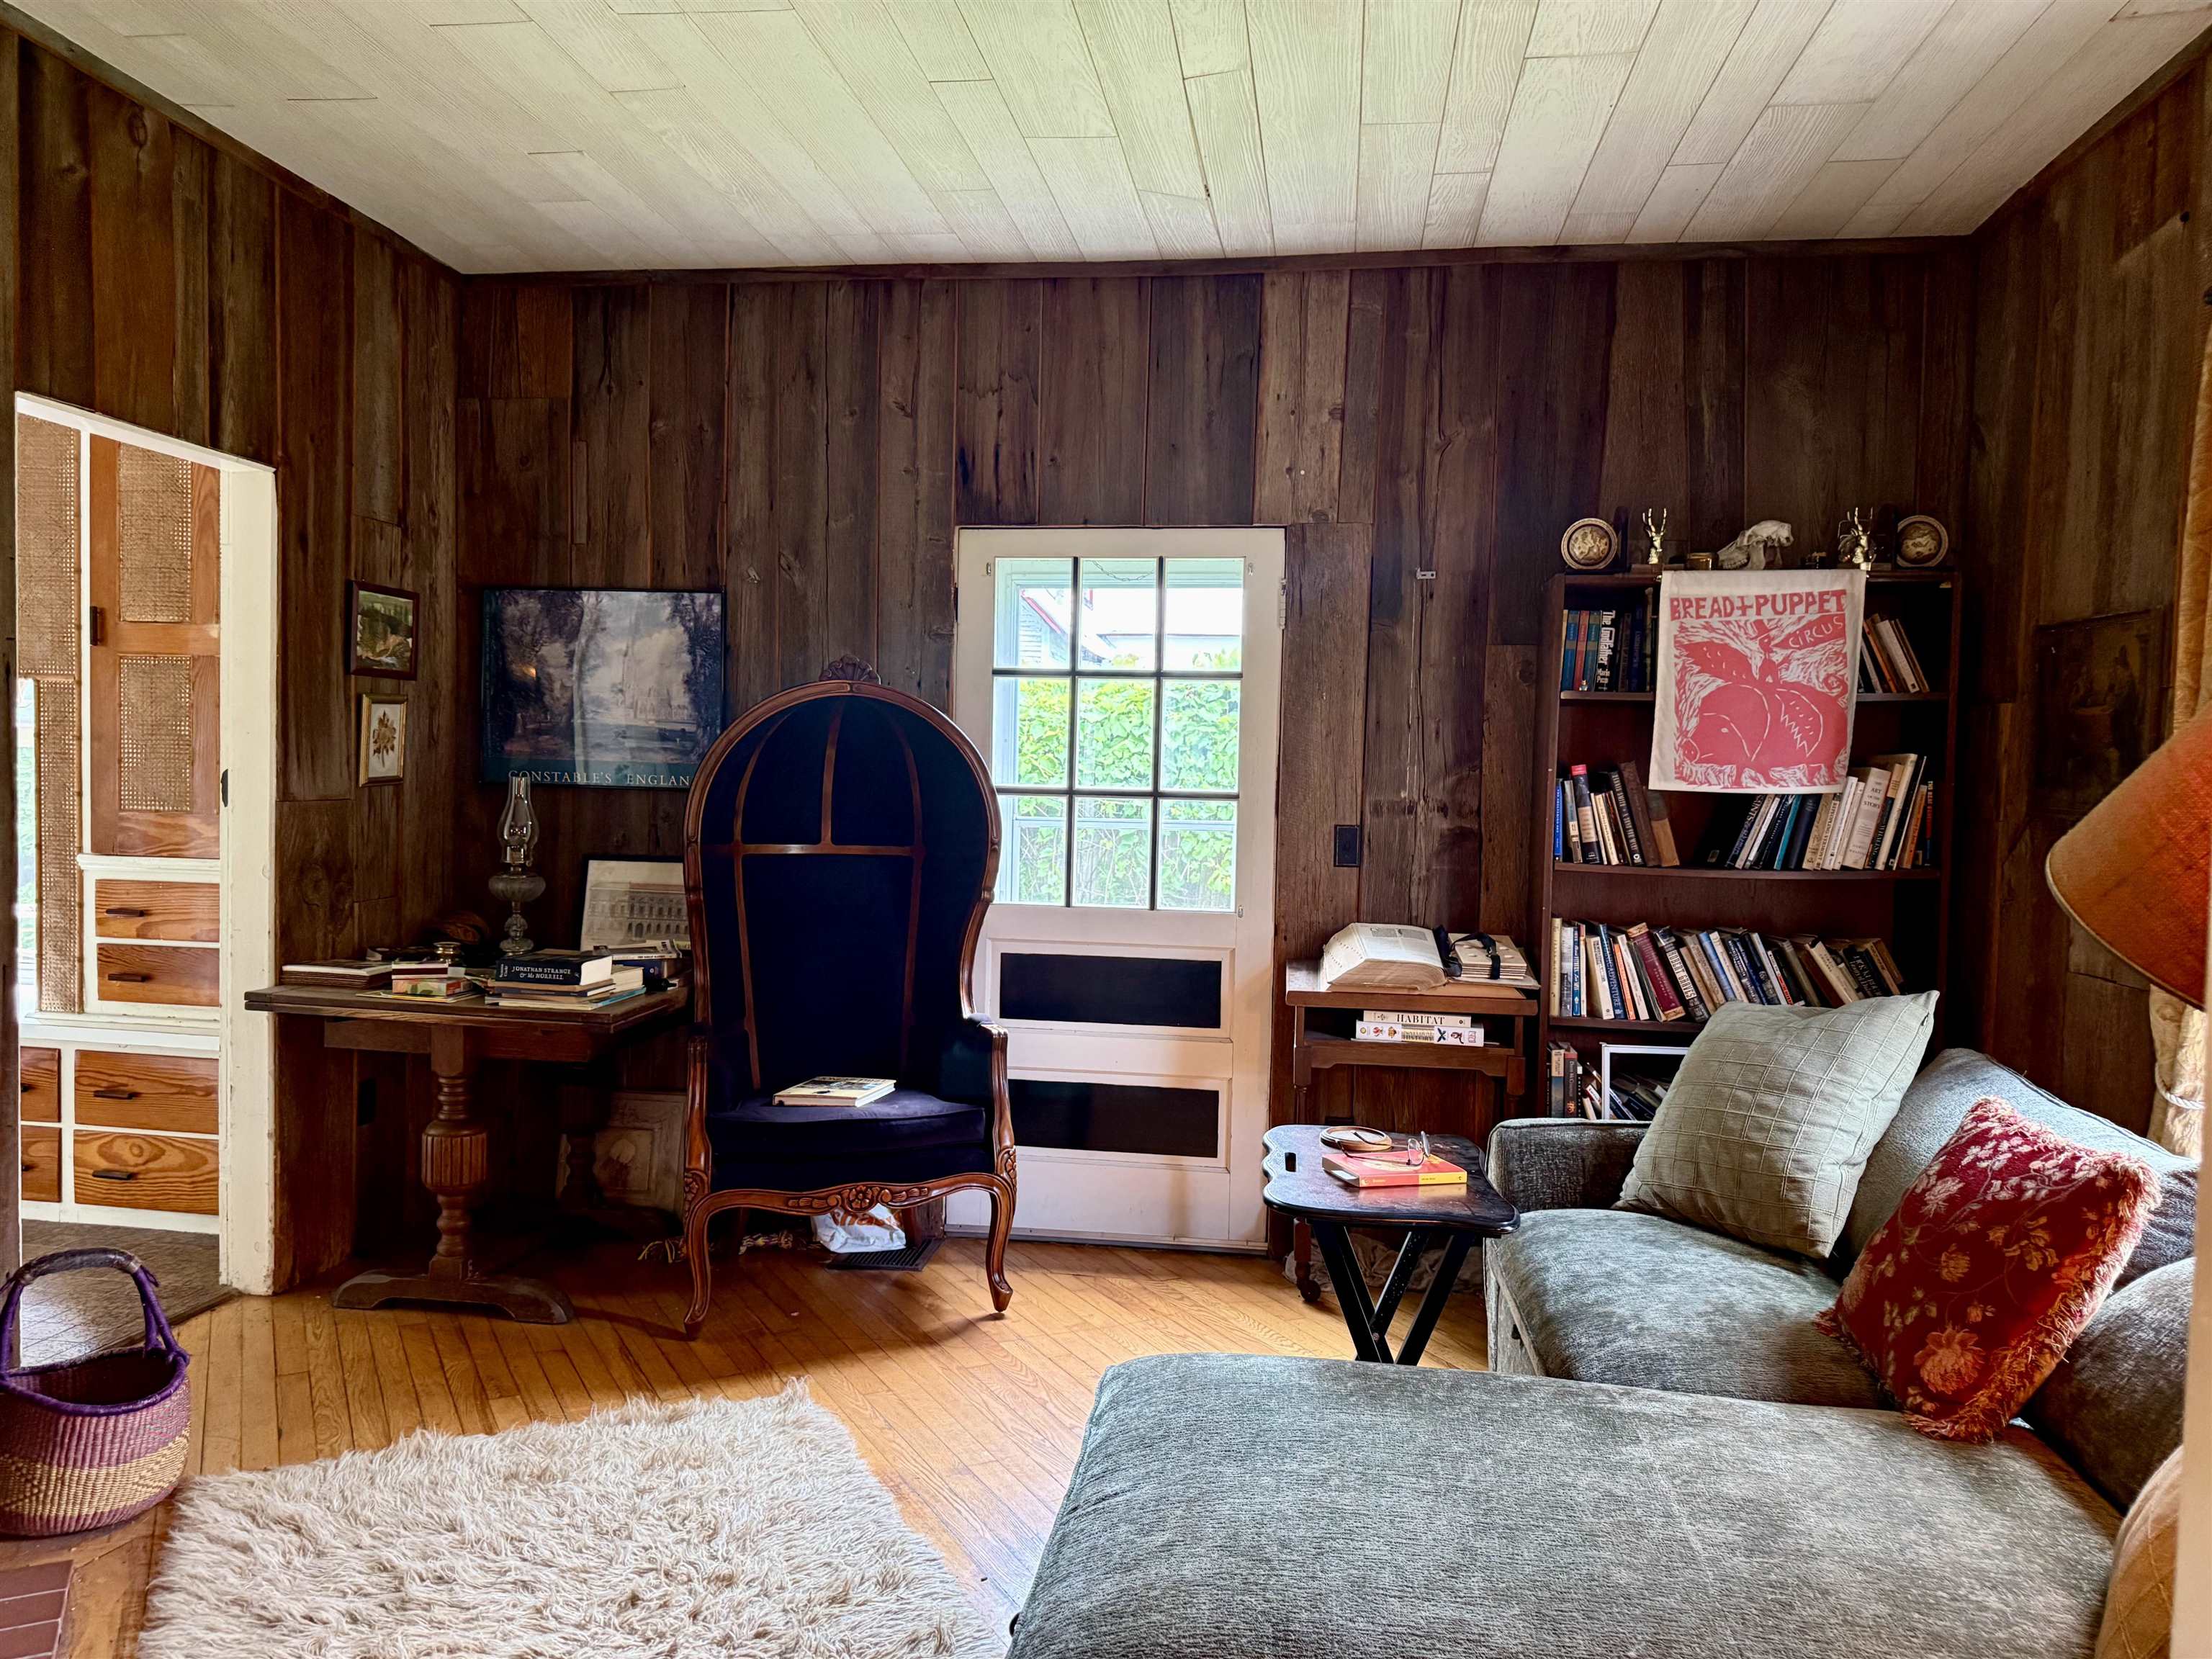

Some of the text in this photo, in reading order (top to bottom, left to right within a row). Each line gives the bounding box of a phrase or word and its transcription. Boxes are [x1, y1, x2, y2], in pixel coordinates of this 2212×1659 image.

[1598, 609, 1615, 665] The Godfather
[627, 773, 690, 786] ENGLAN
[1606, 966, 1622, 1007] ADVENTURE
[1666, 950, 1696, 999] ROBERT GRAVES
[1397, 1014, 1445, 1025] HABITAT
